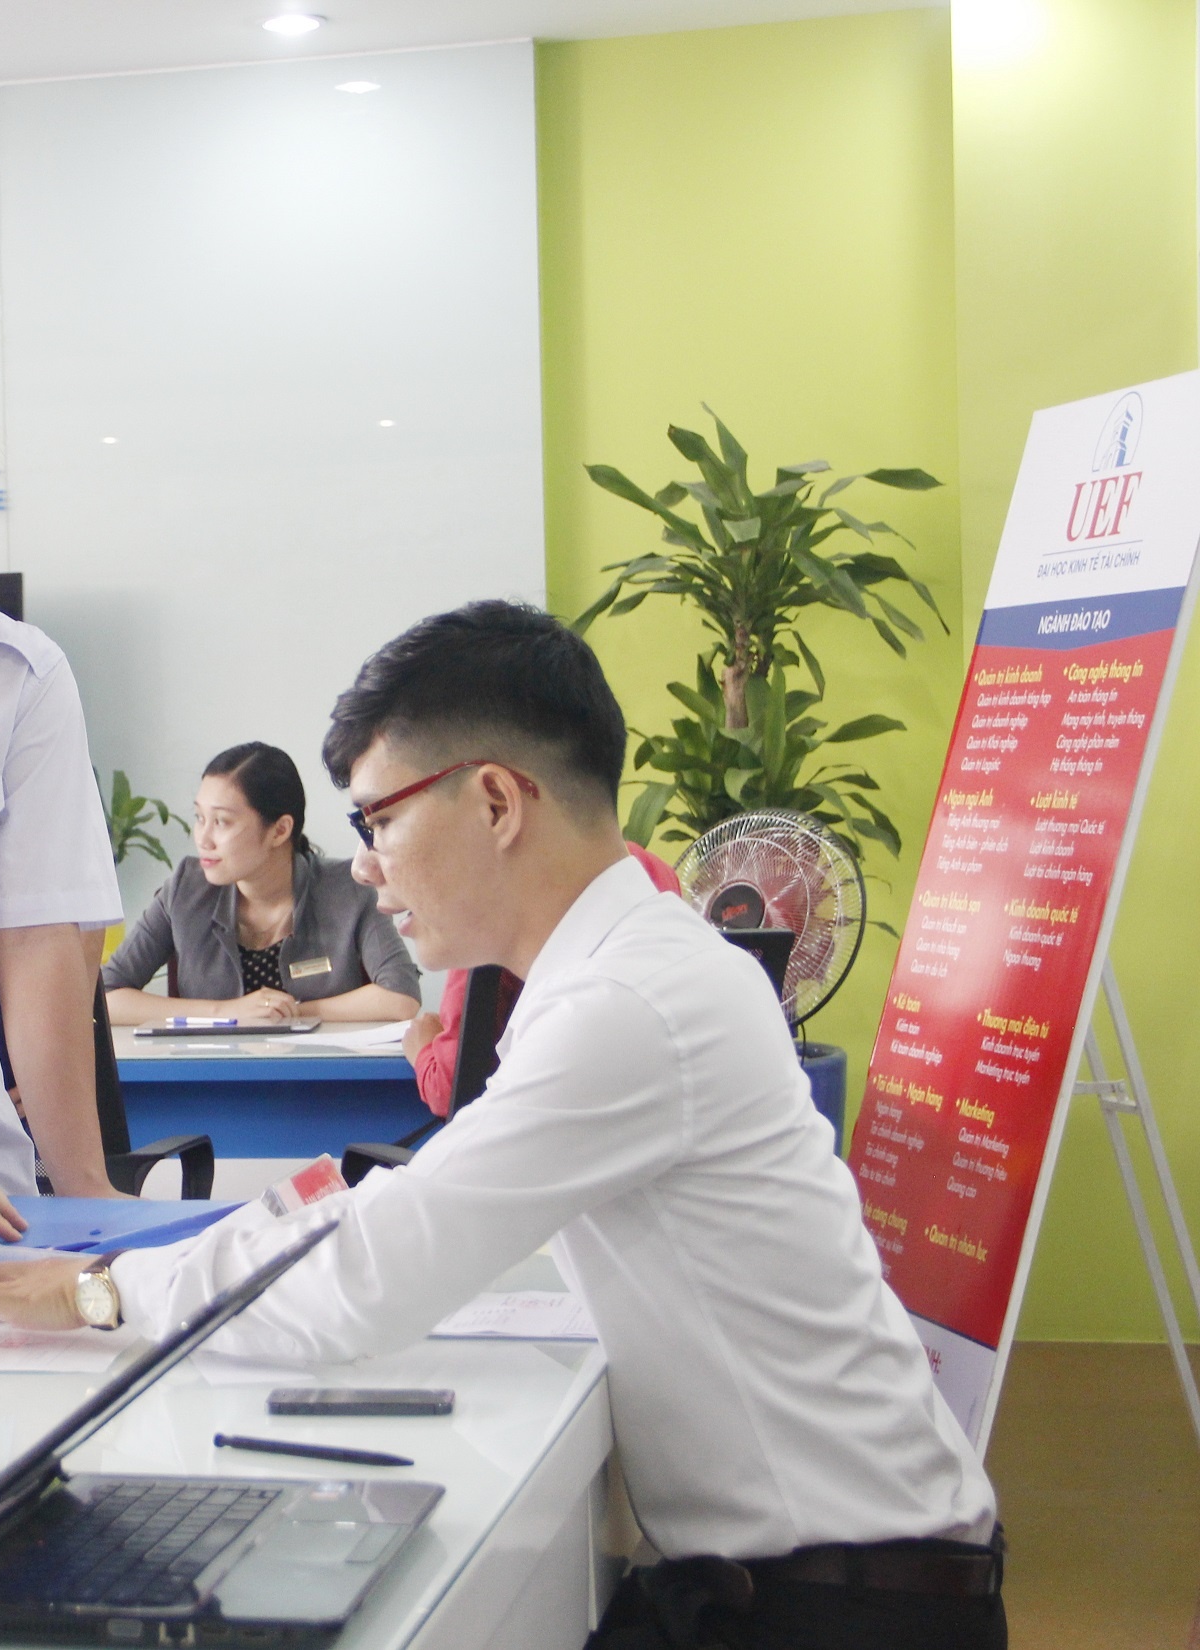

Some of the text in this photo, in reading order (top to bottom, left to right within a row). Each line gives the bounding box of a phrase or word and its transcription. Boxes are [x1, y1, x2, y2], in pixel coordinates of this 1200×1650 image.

[1066, 471, 1142, 542] UEF
[1038, 607, 1111, 634] NGÀNH ĐÀO TẠO
